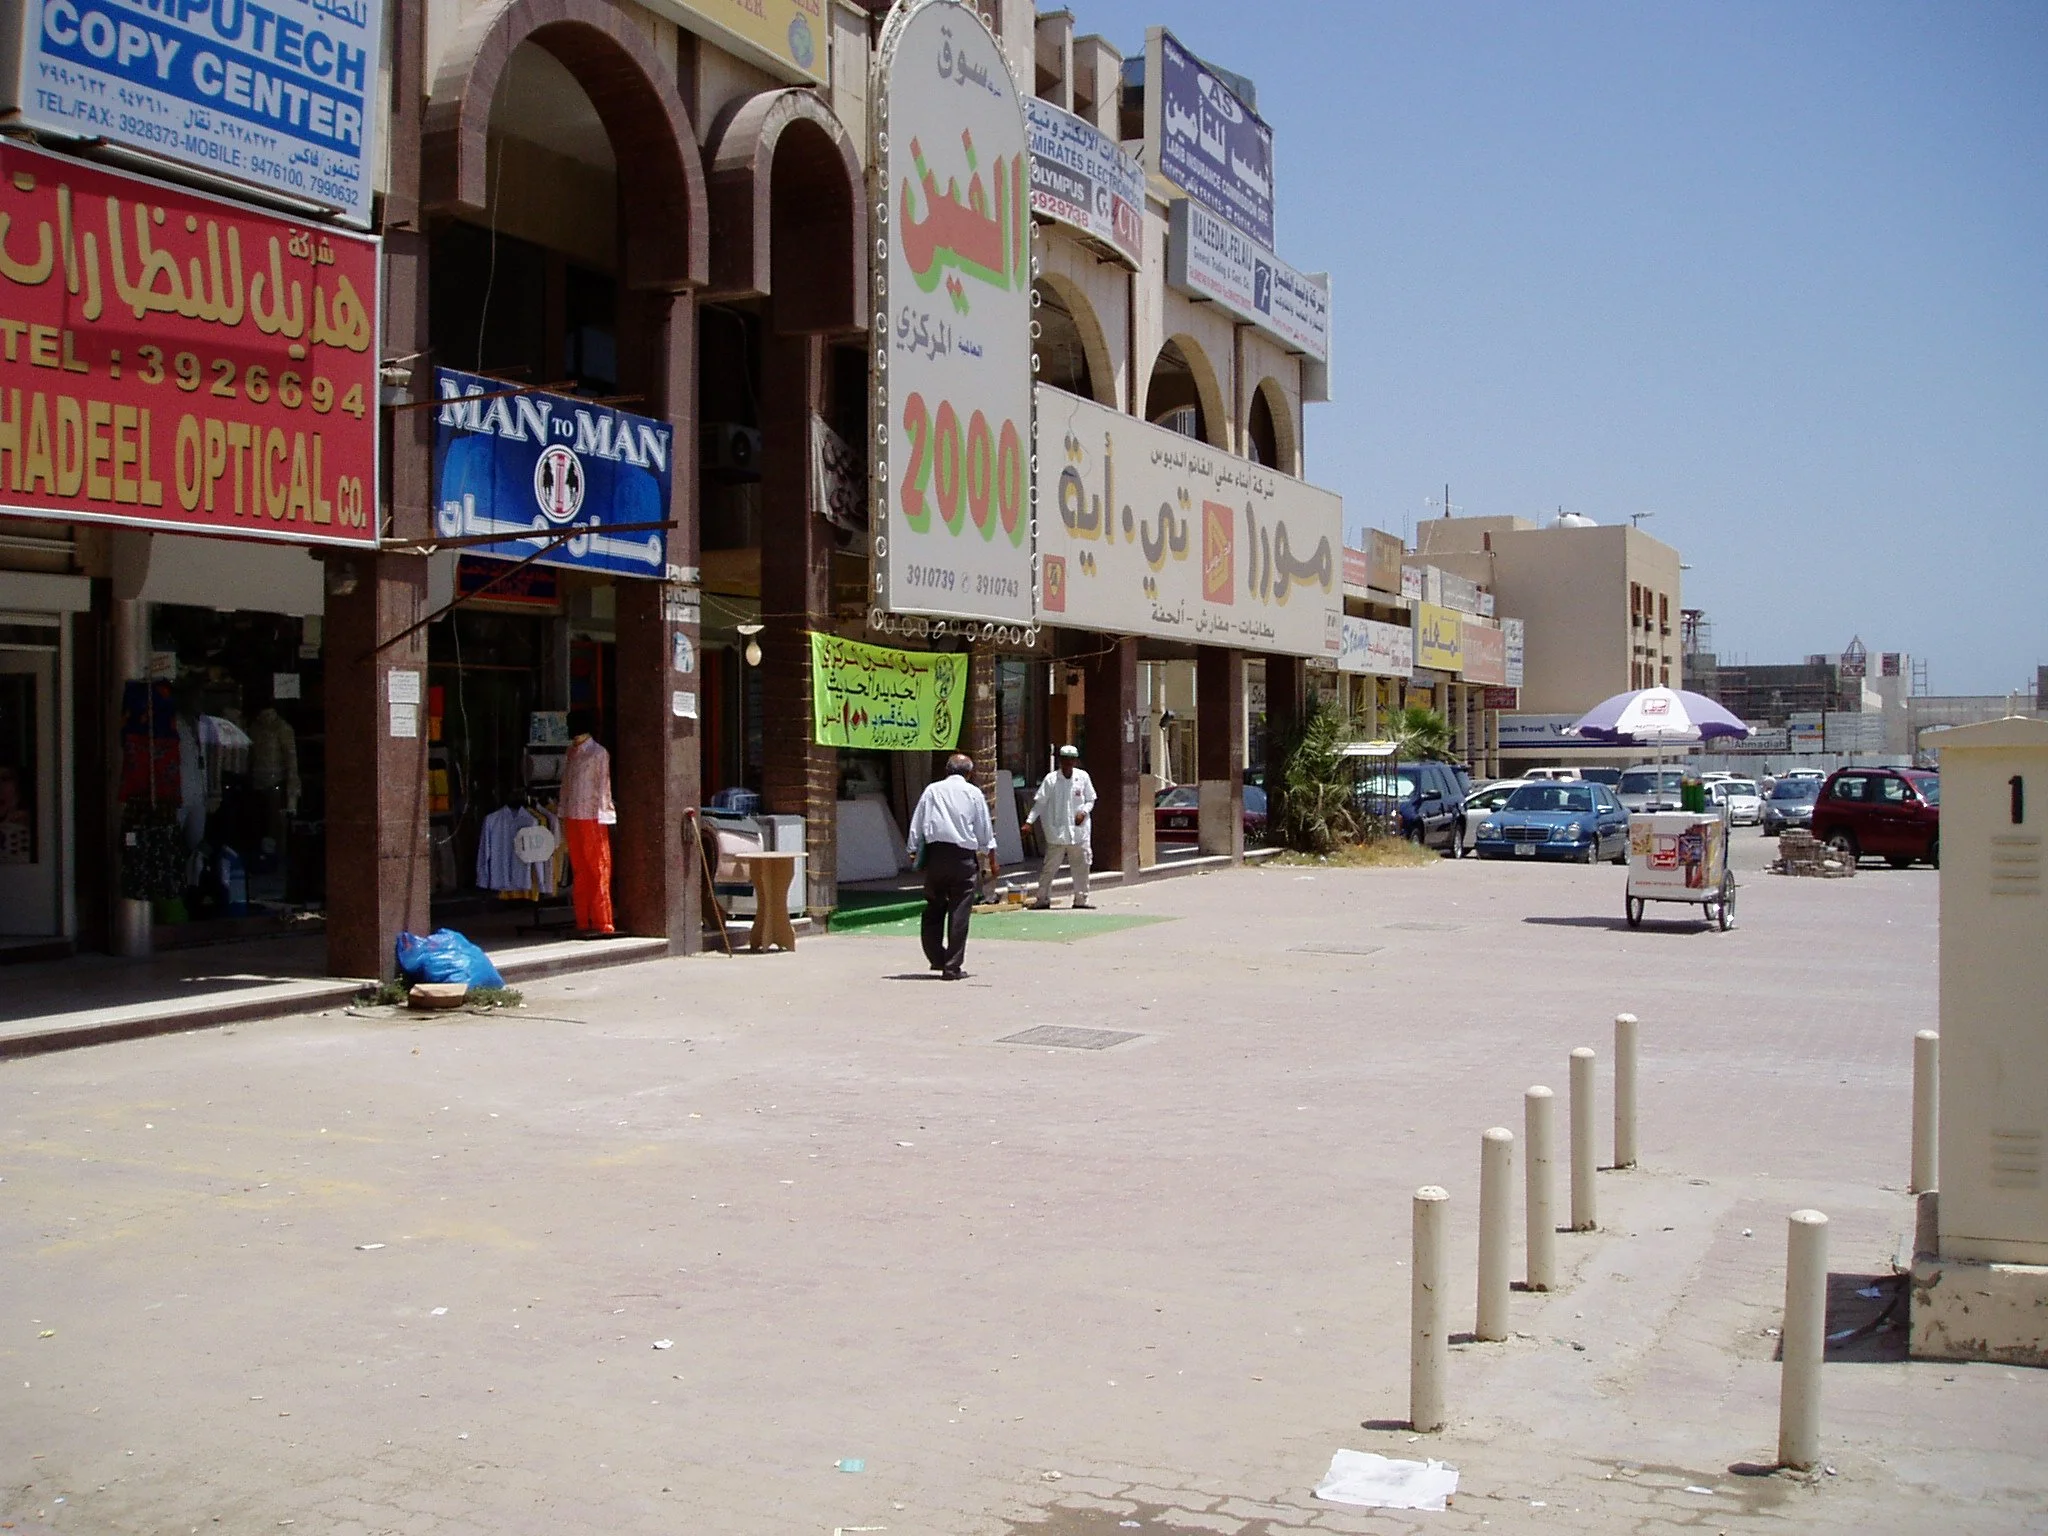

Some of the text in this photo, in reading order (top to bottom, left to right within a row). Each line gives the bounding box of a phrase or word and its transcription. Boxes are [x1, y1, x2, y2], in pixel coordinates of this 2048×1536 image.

[44, 0, 362, 147] COPY CENTER
[937, 25, 988, 89] سوق
[309, 175, 359, 206] 7990632
[1031, 164, 1085, 202] OLYMPUS
[287, 228, 336, 267] شركة
[0, 318, 90, 374] TEL
[138, 345, 367, 419] 3926694
[438, 377, 670, 472] MAN TO MAN
[175, 413, 332, 525] OPTICAL
[337, 474, 367, 528] CO.
[900, 391, 1028, 549] 2000
[1214, 468, 1234, 492] علي
[1253, 479, 1275, 498] شركة
[906, 564, 1020, 598] 3910739 3910743
[1238, 618, 1275, 639] بطانيات
[2008, 775, 2025, 825] 1
